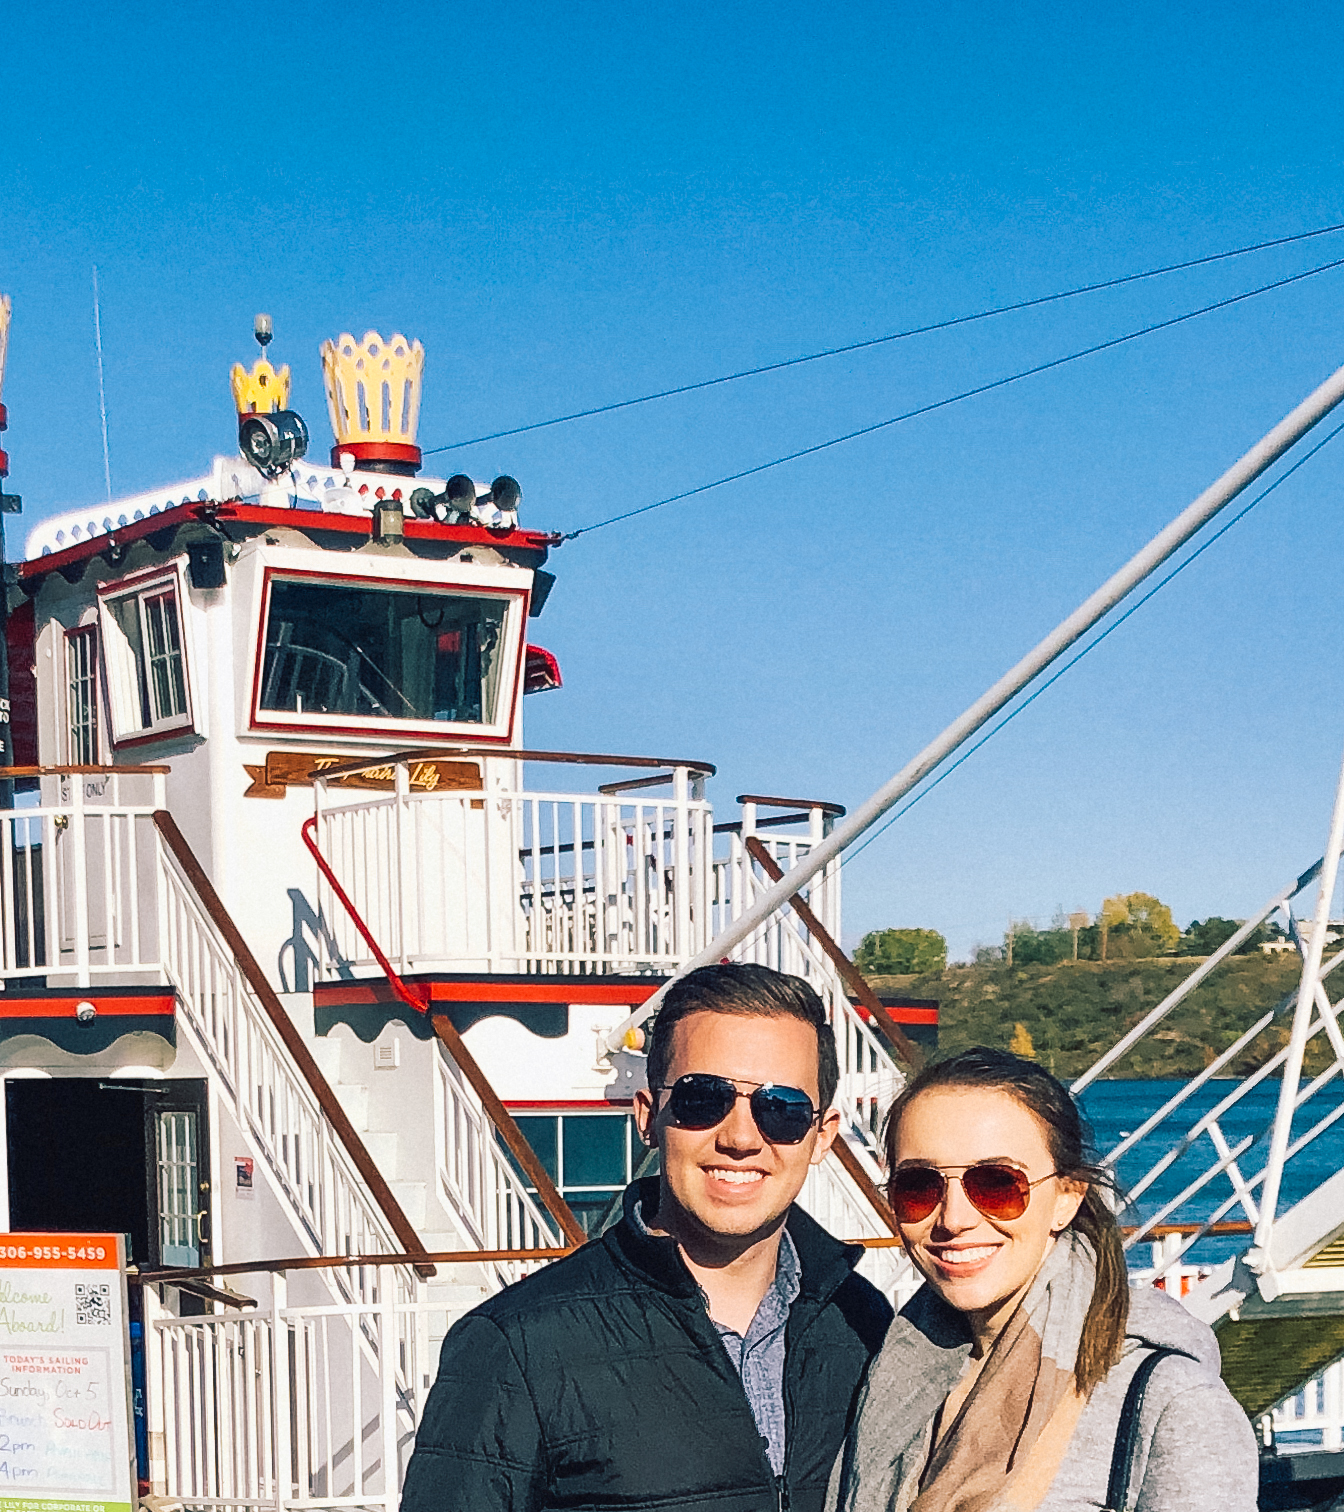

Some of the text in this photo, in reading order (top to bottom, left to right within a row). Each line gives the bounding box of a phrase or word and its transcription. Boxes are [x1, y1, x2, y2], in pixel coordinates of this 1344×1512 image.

[410, 763, 441, 790] Lily
[3, 1355, 89, 1365] TODAY'S SAILING
[11, 1365, 81, 1374] INFORMATION
[55, 1380, 81, 1398] Oct
[85, 1381, 100, 1400] 5
[42, 1503, 91, 1512] CORPORATE
[93, 1504, 105, 1512] OR
